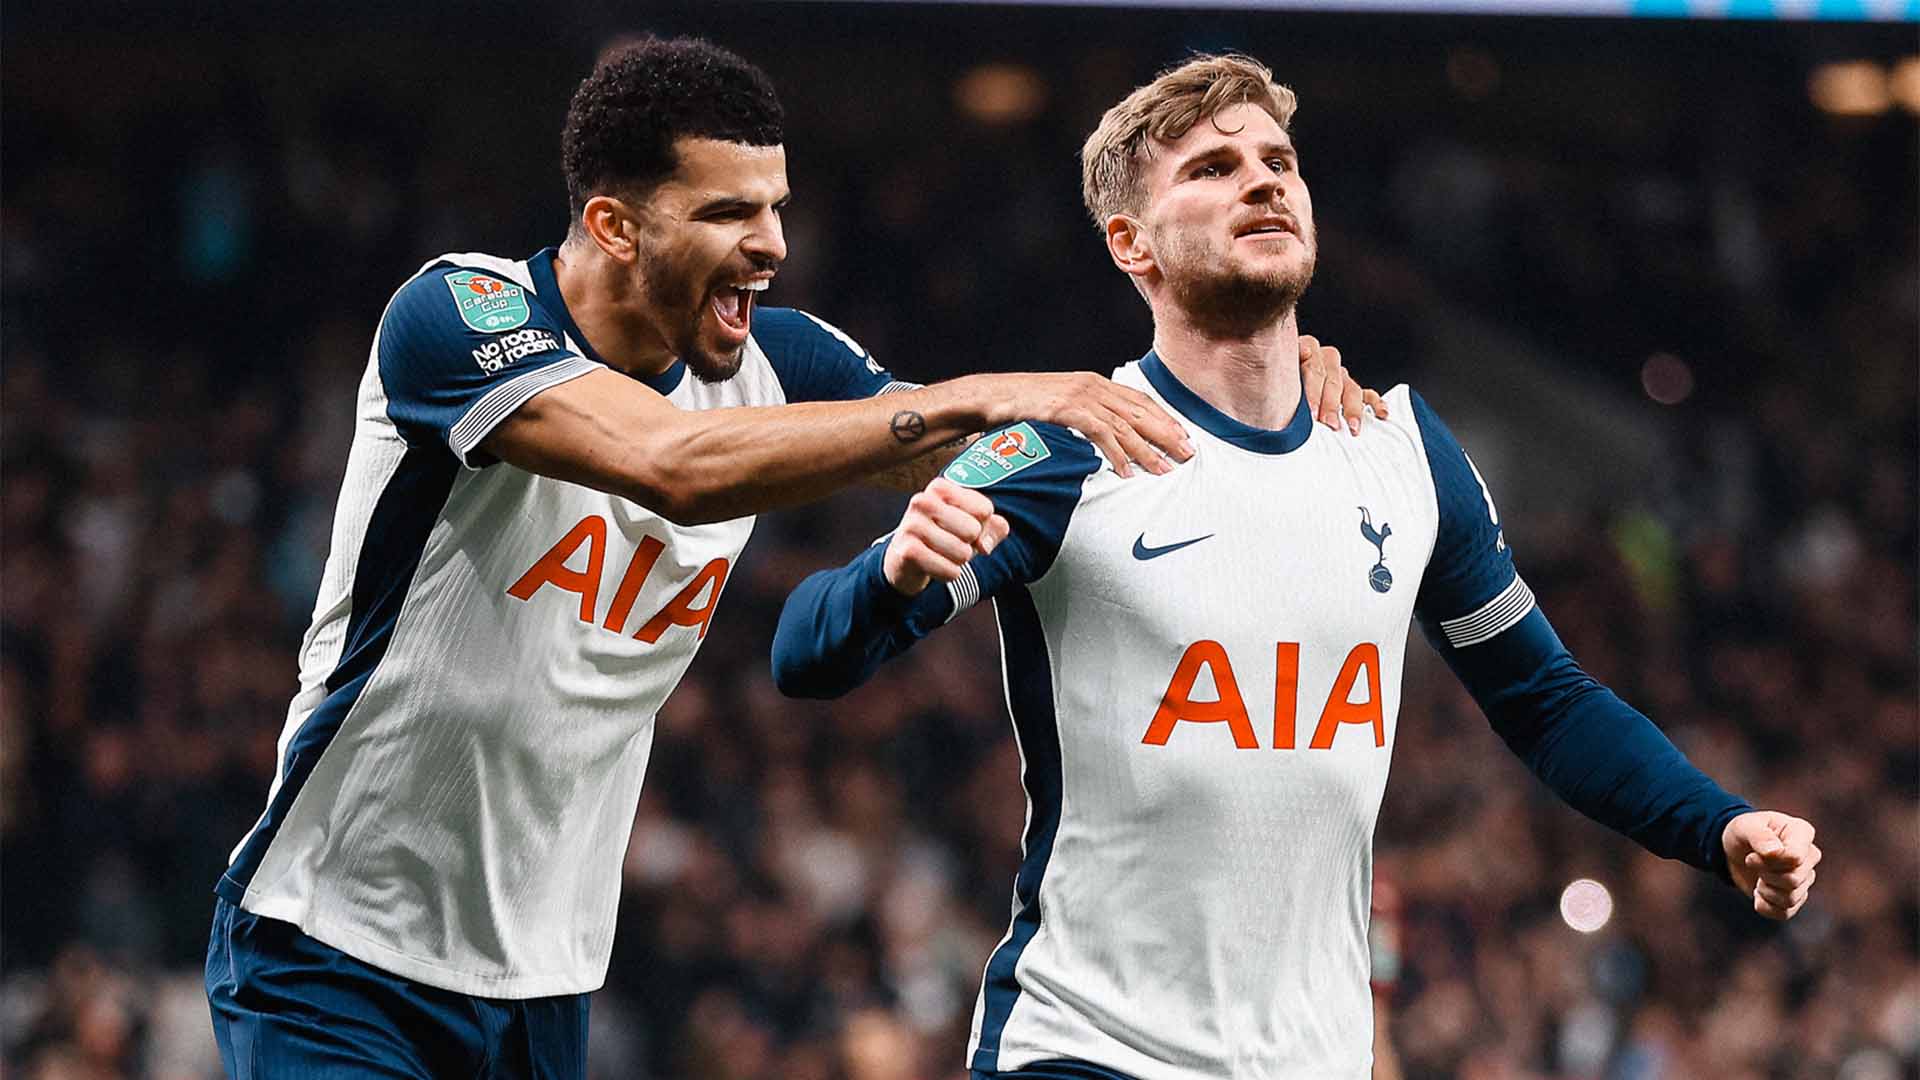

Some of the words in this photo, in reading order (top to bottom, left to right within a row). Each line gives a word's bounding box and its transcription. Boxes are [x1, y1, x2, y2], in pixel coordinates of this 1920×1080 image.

[463, 288, 519, 310] Carabao
[481, 299, 508, 312] Cup
[472, 342, 500, 365] No
[505, 338, 560, 363] racism
[505, 515, 730, 645] AIA
[1141, 639, 1385, 750] AIA
